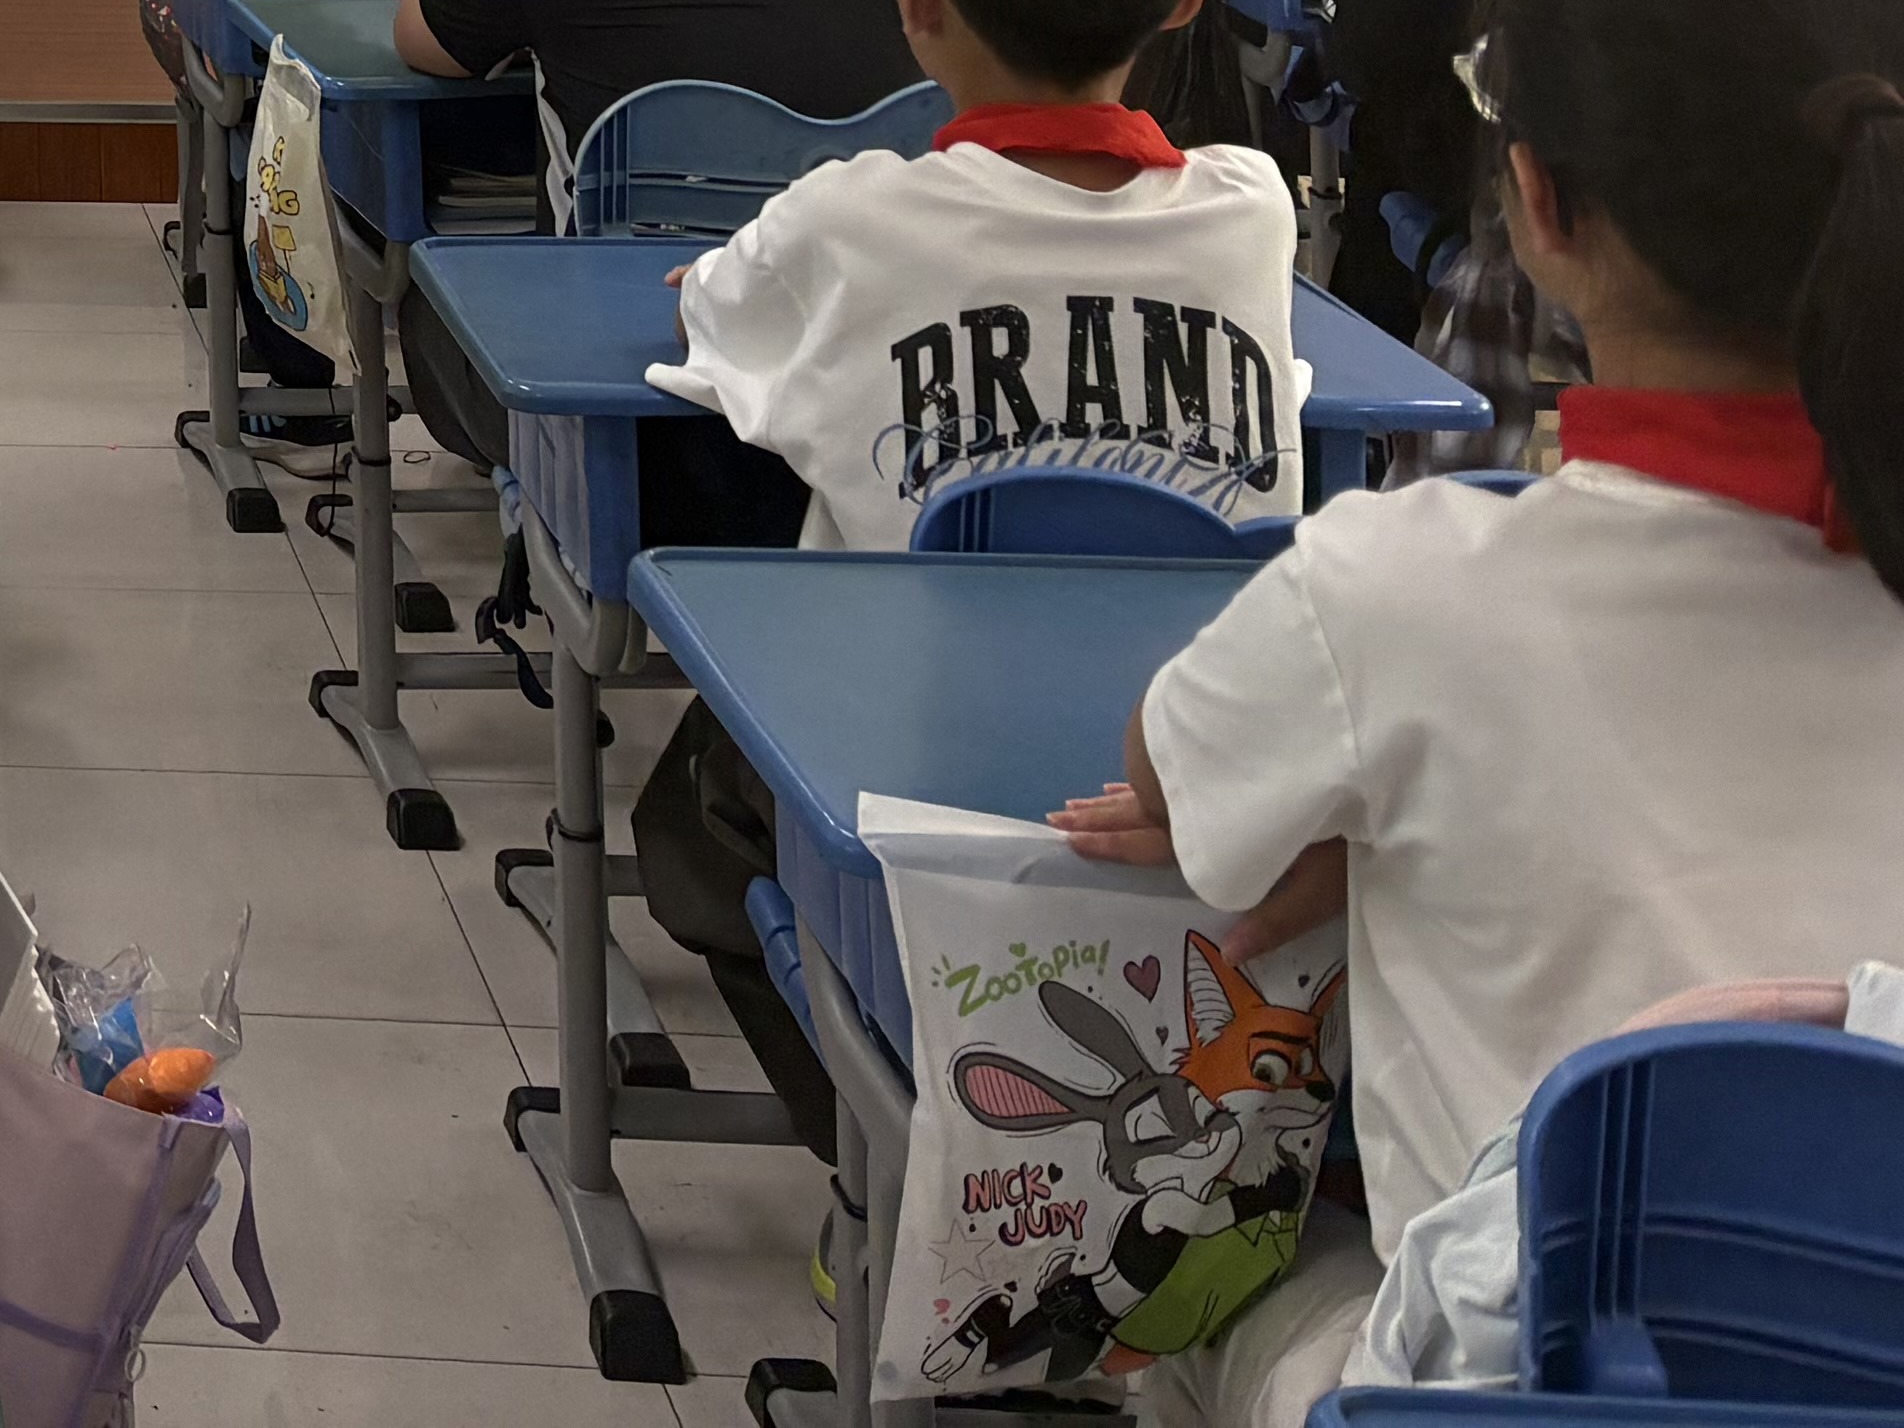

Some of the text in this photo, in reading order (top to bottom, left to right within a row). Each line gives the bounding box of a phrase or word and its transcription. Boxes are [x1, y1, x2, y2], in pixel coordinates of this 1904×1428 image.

[890, 295, 1279, 499] BRAND
[962, 1161, 1052, 1215] NICK
[998, 1199, 1088, 1247] JUDY
